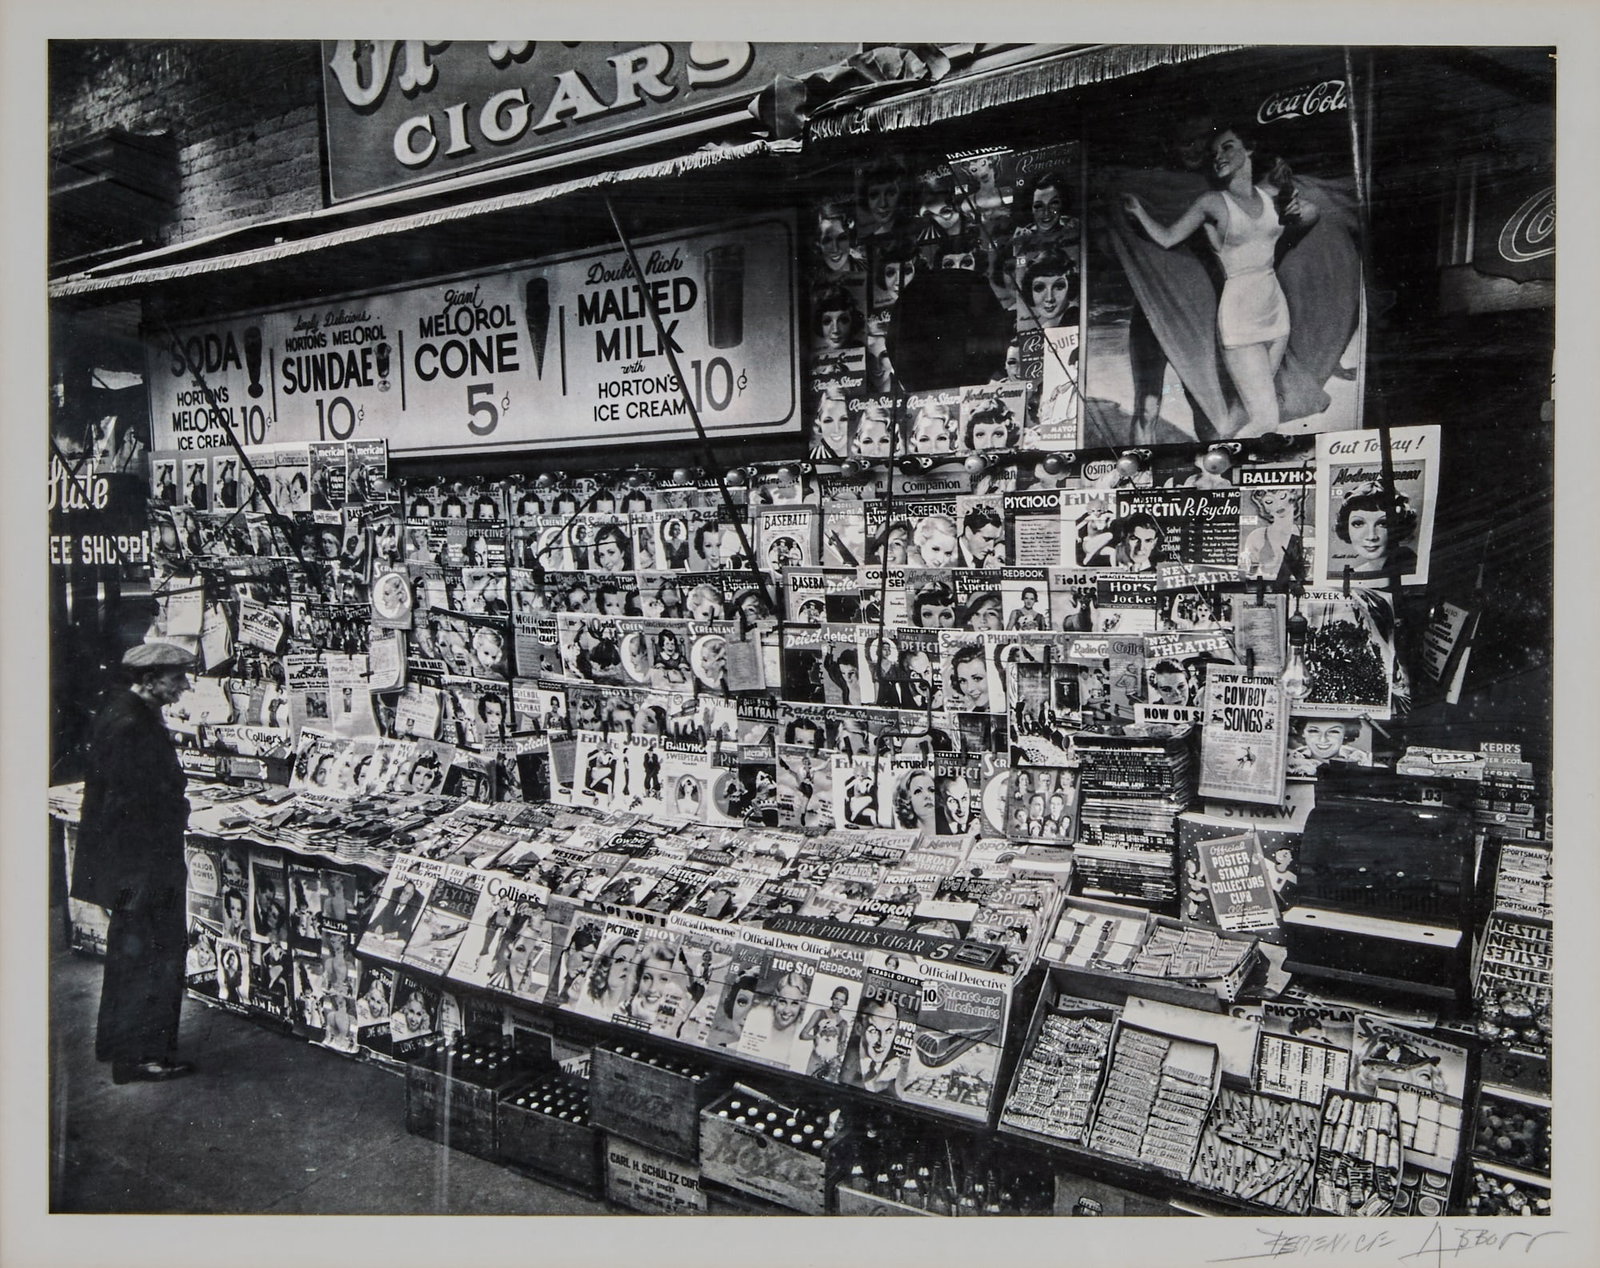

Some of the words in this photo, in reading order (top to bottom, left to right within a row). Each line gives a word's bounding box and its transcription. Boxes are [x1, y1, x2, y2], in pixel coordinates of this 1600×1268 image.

[393, 41, 752, 166] CIGARS
[1257, 80, 1347, 124] Coca-Cola
[645, 247, 684, 276] Rich
[577, 276, 698, 327] MALTED
[418, 304, 517, 339] MELOROL
[285, 332, 328, 353] HORTON'S
[333, 324, 387, 347] MELOROL
[595, 319, 685, 363] MILK
[414, 331, 520, 382] CONE
[282, 346, 374, 395] SUNDAE
[598, 374, 681, 399] HORTON'S
[593, 405, 620, 422] ICE
[626, 398, 687, 420] CREAM
[177, 436, 194, 450] ICE
[1328, 439, 1359, 455] Out
[902, 480, 961, 494] Companion
[907, 502, 940, 517] SCREEN
[763, 513, 808, 531] BASEBALL
[468, 527, 504, 538] DETECTIVE
[1002, 568, 1044, 578] REDBOOK
[1164, 570, 1241, 588] THEATRE
[1149, 634, 1180, 646] NEW
[1152, 635, 1229, 658] THEATRE
[1218, 674, 1240, 685] NEW
[1241, 675, 1277, 686] EDITION
[1223, 685, 1267, 707] COWBOY
[1144, 707, 1170, 720] NOW
[1173, 708, 1189, 721] ON
[1223, 707, 1264, 734] SONGS
[1480, 741, 1521, 754] KERR'S
[904, 852, 958, 867] RAILROAD
[1211, 851, 1250, 869] POSTER
[1502, 848, 1549, 862] SPORTSMAN'S
[884, 873, 938, 885] NORTHWEST
[1218, 866, 1250, 881] STAMP
[1498, 874, 1546, 887] SPORTSMAN'S
[486, 876, 541, 905] Collier's
[1211, 876, 1265, 894] COLLECTORS
[858, 897, 915, 918] HORROR
[1495, 900, 1544, 914] SPORTSMAN'S
[978, 904, 1034, 929] SPIDER
[604, 922, 640, 939] PICTURE
[669, 914, 700, 932] Official
[699, 919, 737, 939] Detective
[772, 918, 818, 937] BAYUK
[817, 924, 879, 946] PHILLIES
[741, 930, 775, 949] Official
[818, 959, 864, 979] REDBOOK
[896, 973, 906, 981] OF
[918, 963, 959, 983] Official
[957, 970, 1008, 991] Detective
[921, 988, 937, 1003] 10
[981, 995, 1001, 1007] and
[609, 1152, 631, 1170] CARL
[641, 1163, 680, 1185] SCHULTZ
